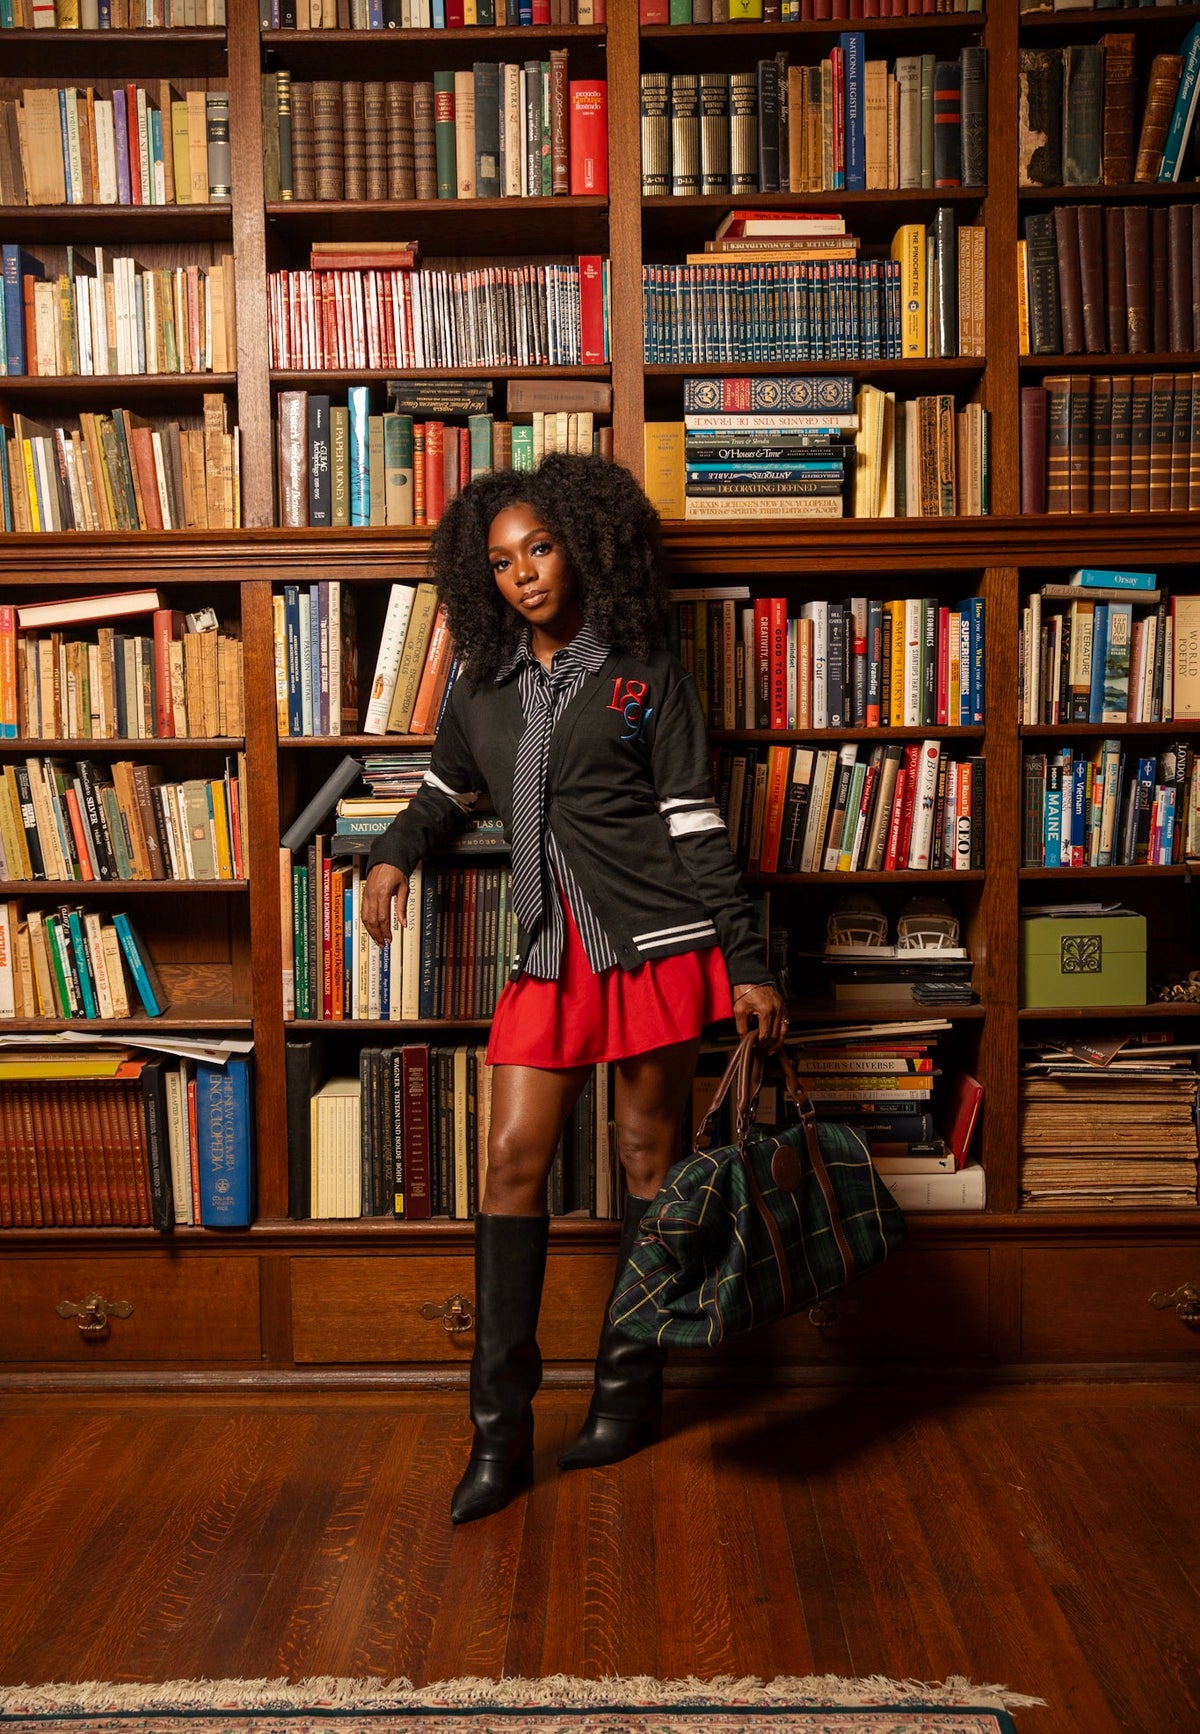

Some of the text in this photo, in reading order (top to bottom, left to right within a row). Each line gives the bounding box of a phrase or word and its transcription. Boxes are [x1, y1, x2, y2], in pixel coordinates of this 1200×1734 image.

[290, 399, 299, 439] Webster's
[694, 417, 839, 425] LES GRANDS VINS DE FRANCE
[336, 465, 344, 502] MONEY
[777, 484, 817, 492] DEFINED
[290, 489, 301, 527] Dictionary
[1114, 575, 1138, 585] Orsay
[393, 605, 409, 672] ELEMENTS
[926, 607, 934, 647] INFONOMICS
[401, 641, 414, 675] OF DOLLS
[401, 606, 431, 714] THE ENCYCLOPEDIA
[760, 616, 769, 674] CREATIVITY, INC.
[974, 602, 983, 691] How you you do
[1082, 623, 1091, 676] LITERATURE
[1179, 638, 1188, 677] POETRY
[1189, 630, 1198, 677] WORLD
[775, 662, 782, 675] TO
[816, 657, 826, 680] four
[869, 662, 878, 696] branding
[606, 677, 648, 720] 18
[1176, 744, 1188, 783] LONDON
[135, 771, 146, 807] LATIN
[1076, 781, 1084, 815] Vietnam
[1139, 780, 1152, 811] Brazil
[86, 796, 98, 825] SILVER
[350, 822, 392, 832] NATION
[472, 820, 493, 828] TLAS
[958, 768, 970, 855] THE ROAD TO CEO
[1048, 793, 1059, 841] MAINE
[1166, 815, 1174, 839] French
[877, 805, 891, 855] TRADING UP
[890, 825, 899, 858] OPPORTUNITY
[61, 908, 70, 928] Zorro
[333, 892, 342, 924] Antiques
[333, 931, 342, 958] Jewelry
[333, 958, 342, 986] Designs
[849, 1061, 895, 1069] UNIVERSE
[209, 1074, 223, 1172] ENCYCLOPEDIA
[224, 1076, 235, 1172] THE NEW COLUMBIA
